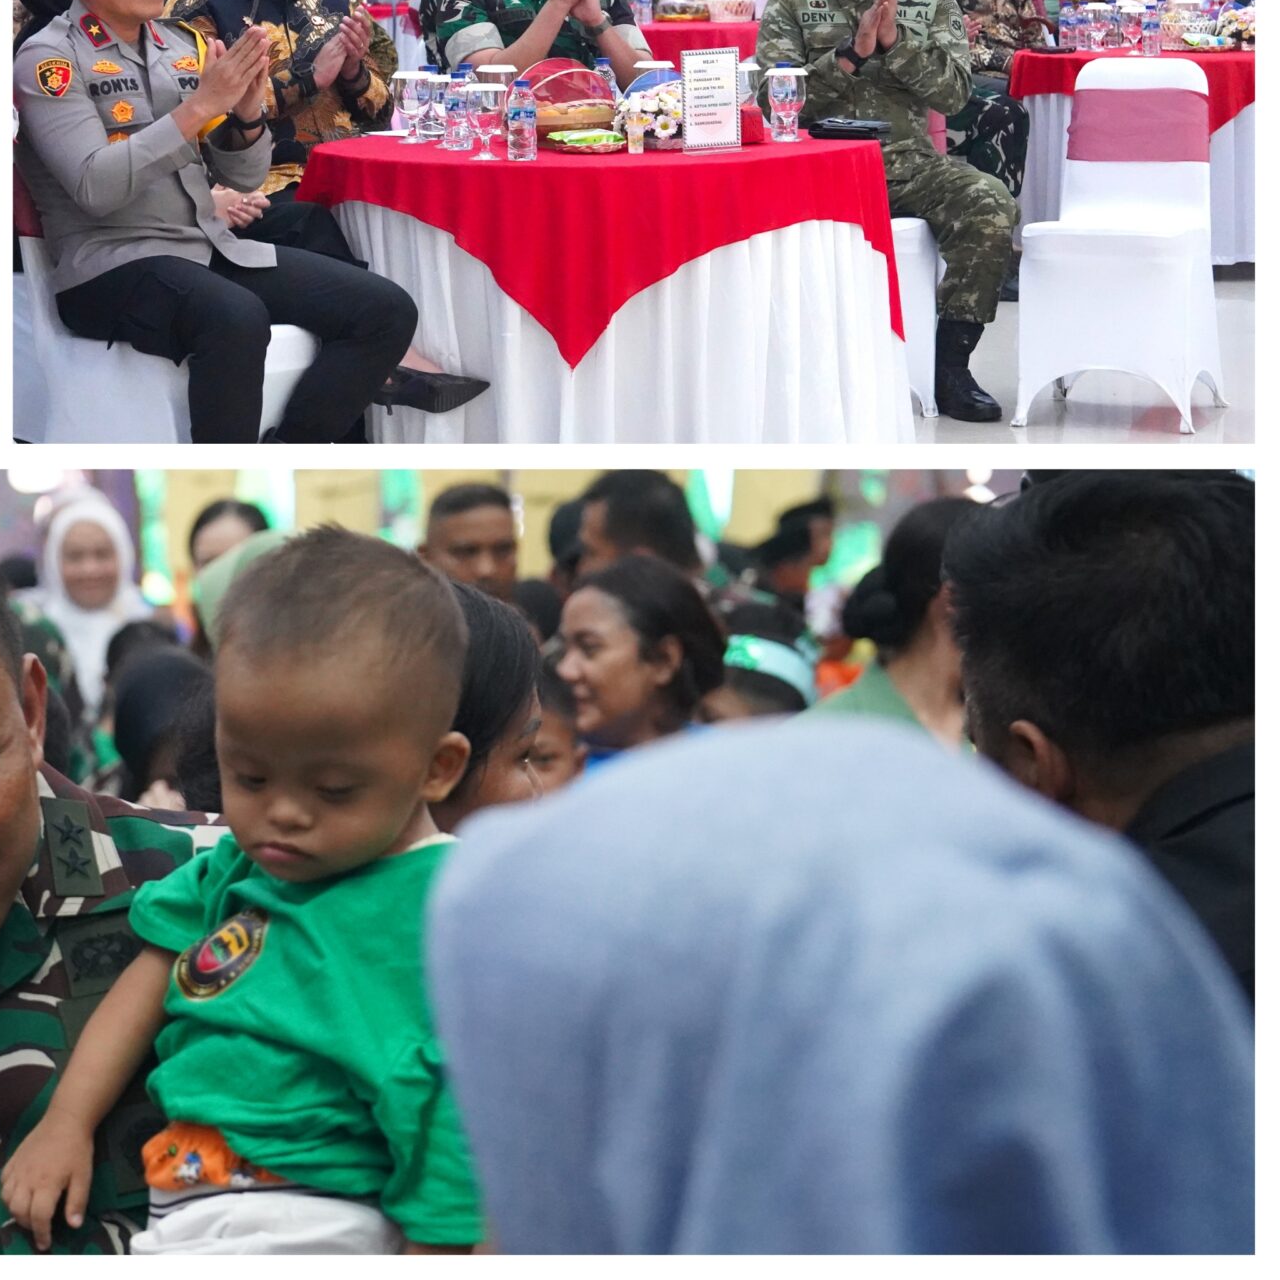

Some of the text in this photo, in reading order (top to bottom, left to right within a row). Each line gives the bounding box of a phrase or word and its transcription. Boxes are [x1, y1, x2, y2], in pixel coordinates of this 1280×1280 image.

[801, 12, 836, 23] DENY
[896, 9, 931, 22] NI AL
[88, 77, 140, 97] RONY.S
